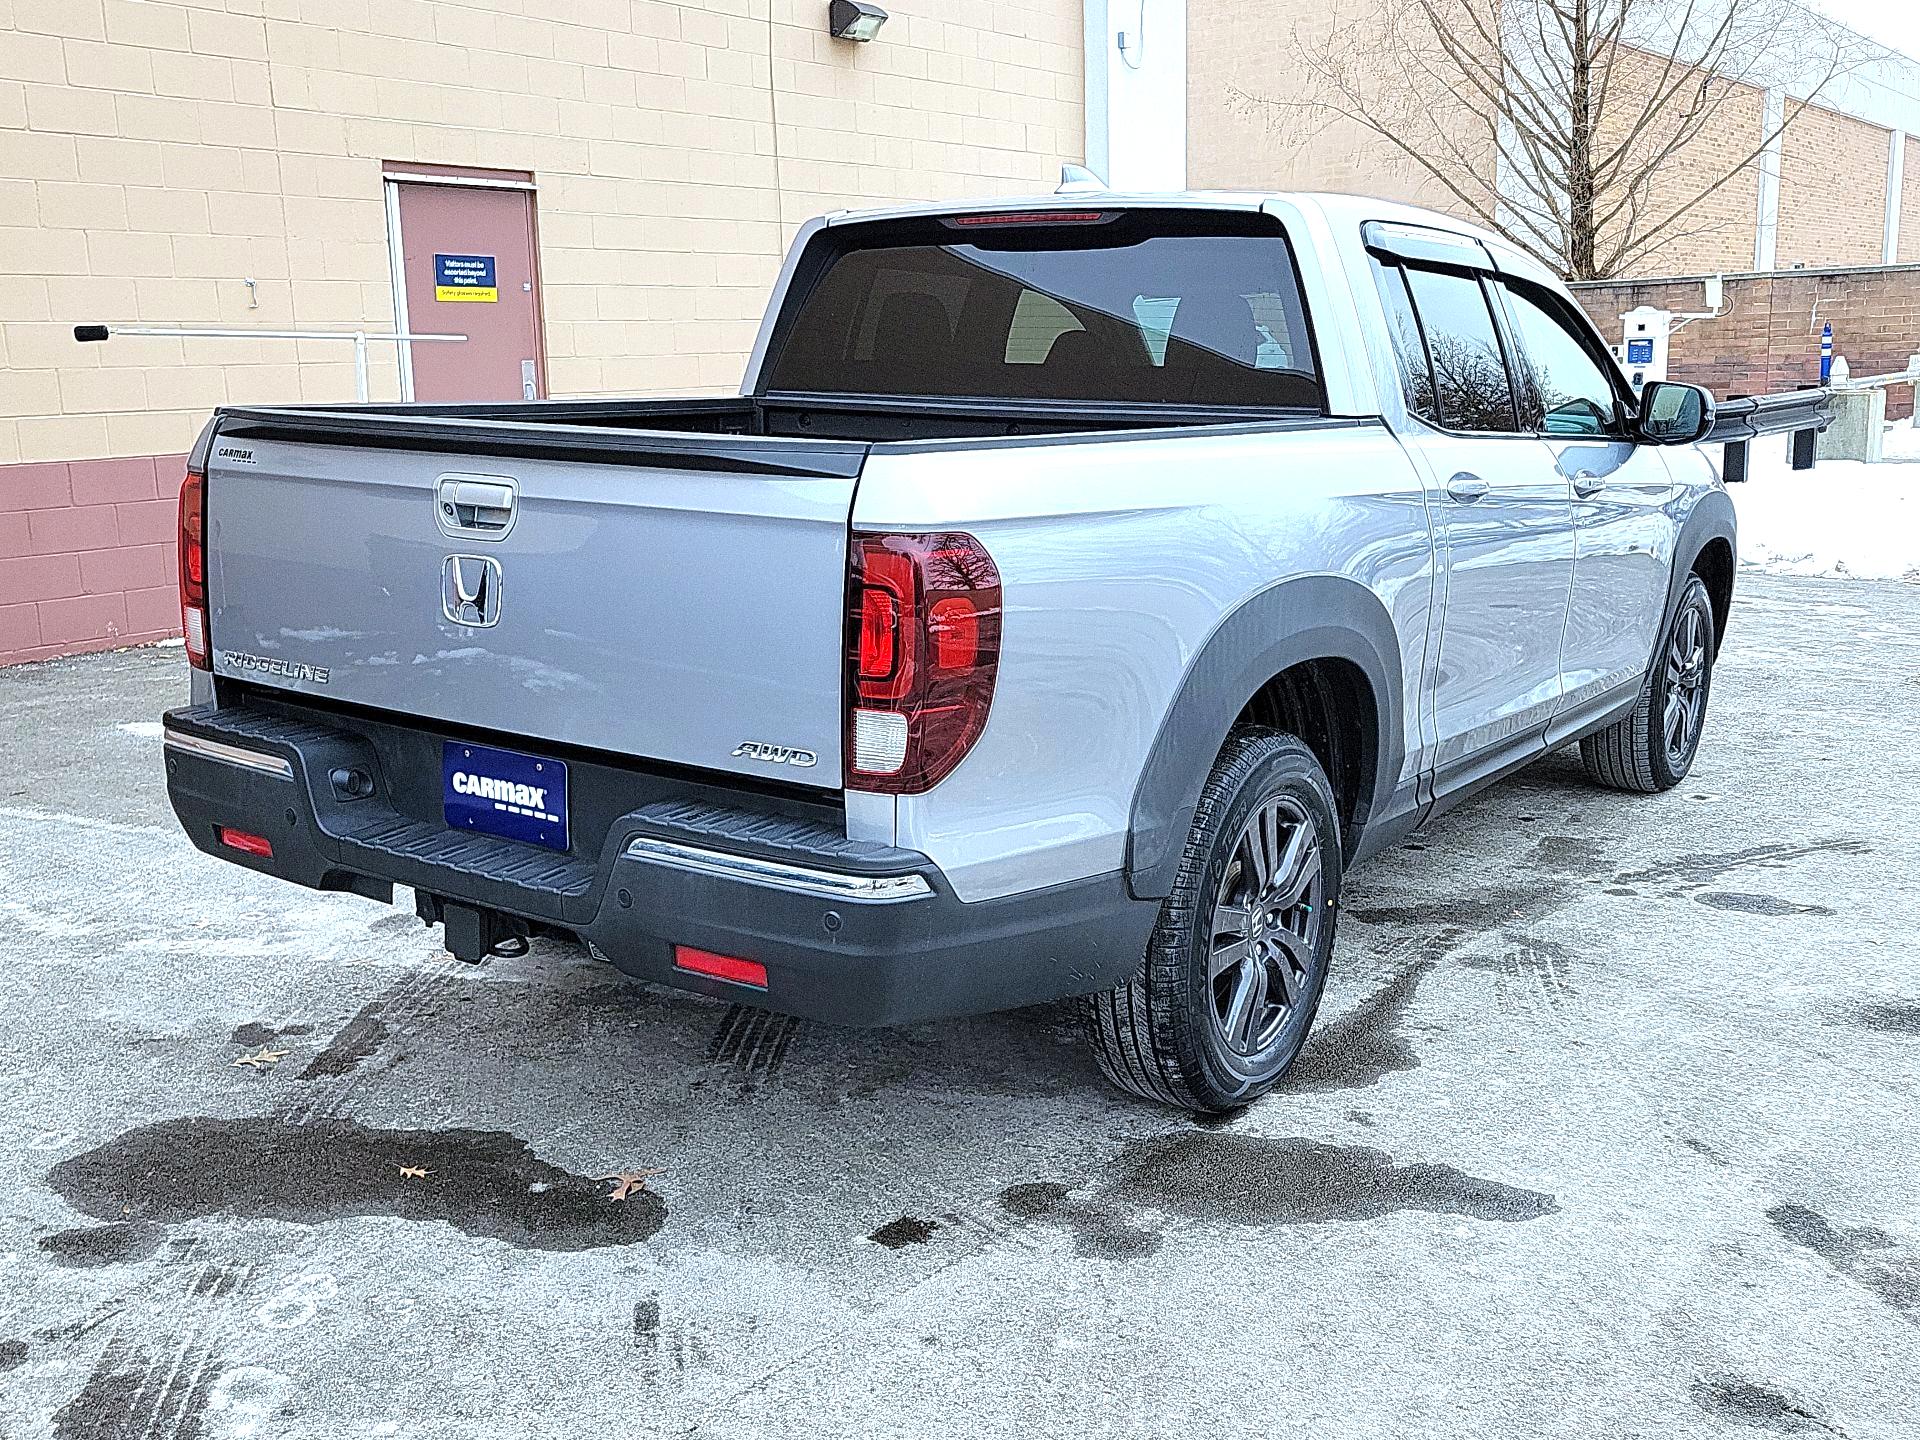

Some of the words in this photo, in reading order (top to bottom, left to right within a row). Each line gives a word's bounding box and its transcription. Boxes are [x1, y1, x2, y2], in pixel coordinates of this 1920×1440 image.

[477, 261, 485, 269] be
[453, 276, 463, 284] this
[223, 650, 330, 684] RIDGELINE
[731, 740, 818, 767] AWD
